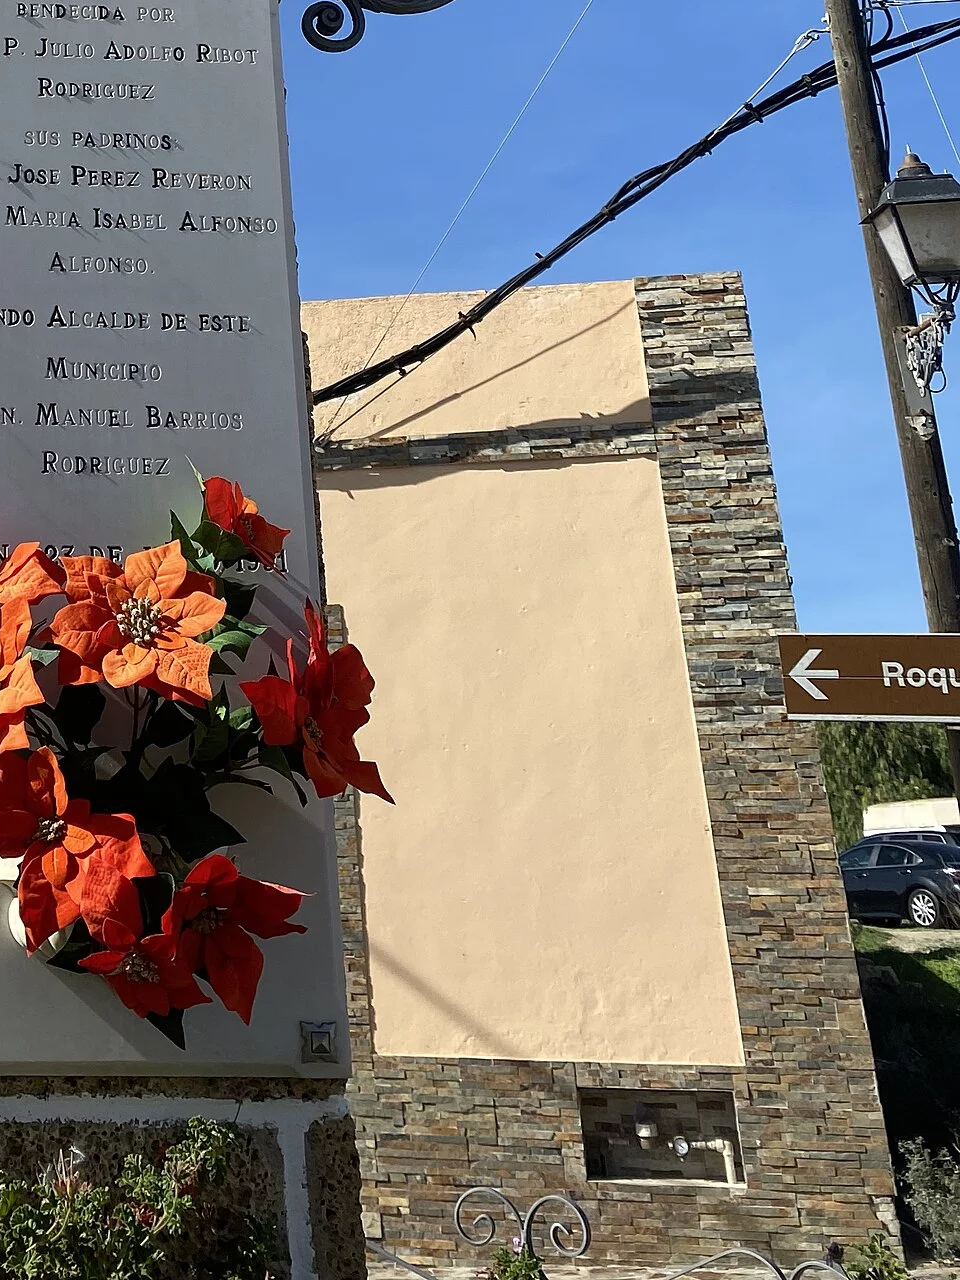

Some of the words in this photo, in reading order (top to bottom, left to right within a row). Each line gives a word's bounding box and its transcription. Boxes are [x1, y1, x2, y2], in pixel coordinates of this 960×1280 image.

[16, 2, 126, 21] BENDECIDA
[138, 7, 175, 22] POR
[3, 37, 26, 57] P.
[34, 38, 95, 59] JULIO
[104, 40, 186, 62] ADOLFO
[196, 43, 258, 64] RIBOT
[38, 77, 155, 100] RODRIGUEZ
[24, 130, 60, 146] SUS
[8, 164, 60, 185] JOSE
[71, 165, 142, 187] PEREZ
[152, 168, 252, 191] REVERON
[4, 205, 82, 228] MARIA
[93, 207, 168, 231] ISABEL
[179, 211, 278, 234] ALFONSO
[47, 305, 151, 330] ALCALDE
[161, 312, 188, 331] DE
[198, 314, 251, 333] ESTE
[44, 357, 162, 382] MUNICIPIO
[34, 403, 134, 428] MANUEL
[145, 405, 244, 431] BARRIOS
[41, 450, 170, 476] RODRIGUEZ
